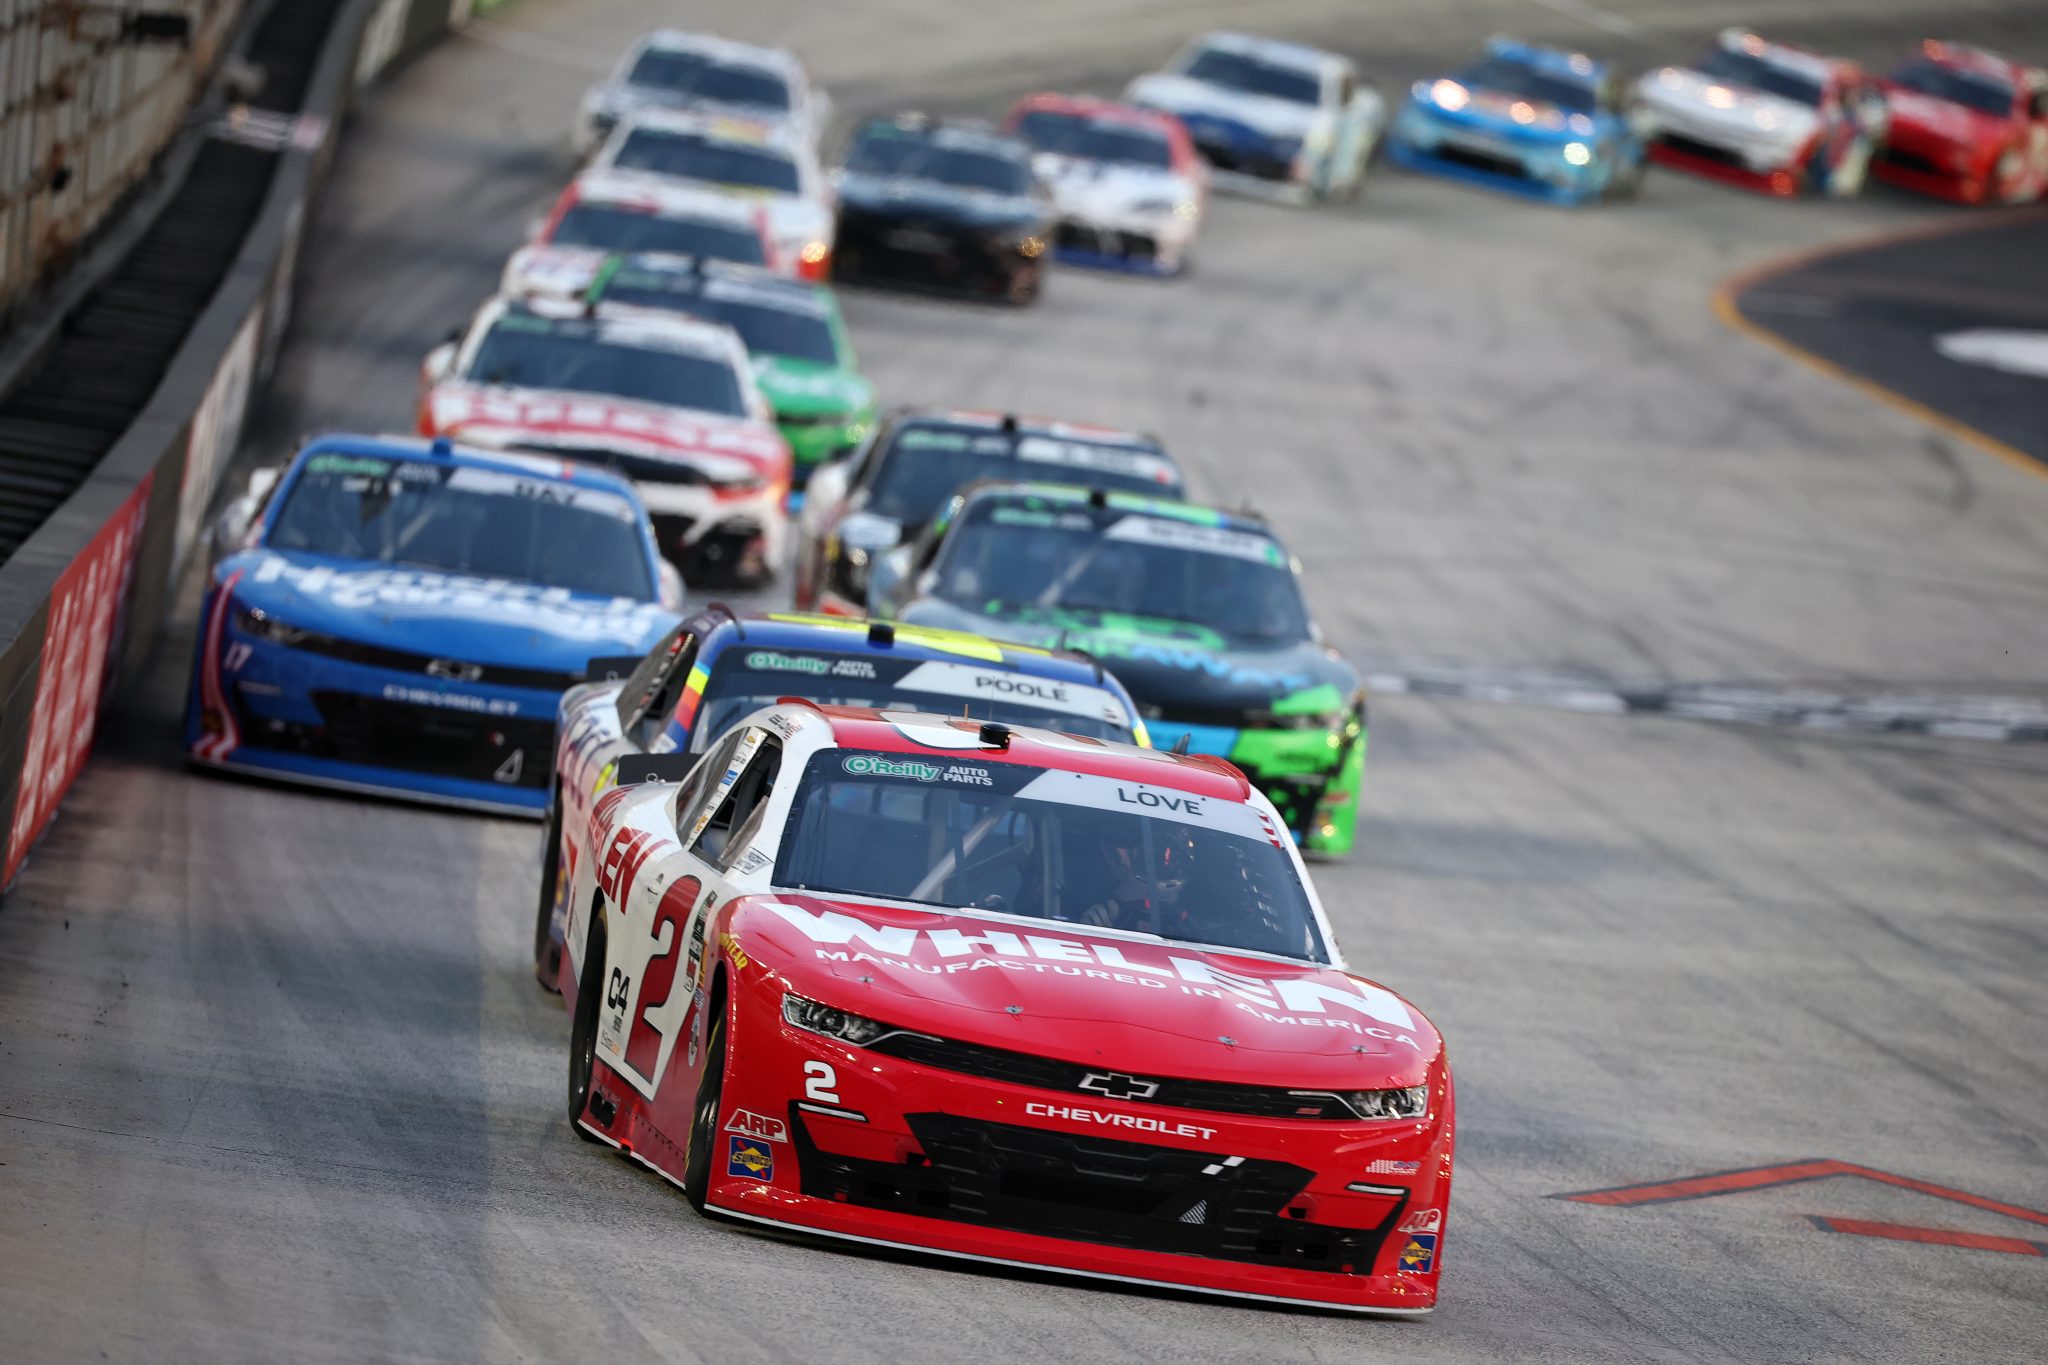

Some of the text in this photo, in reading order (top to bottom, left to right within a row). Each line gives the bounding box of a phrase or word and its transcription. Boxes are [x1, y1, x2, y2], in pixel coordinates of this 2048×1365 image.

[832, 667, 876, 679] PARTS
[838, 660, 873, 670] AUTO
[975, 676, 1069, 701] POOLE
[845, 755, 941, 781] O'Reilly
[943, 772, 993, 786] PARTS
[948, 765, 989, 777] AUTO
[1117, 787, 1203, 816] LOVE
[624, 874, 702, 1086] 2
[758, 903, 1417, 1033] WHELEN
[815, 949, 1422, 1051] MANUFACTURED IN AMERICA
[803, 1060, 840, 1104] 2
[728, 1111, 783, 1137] ARP
[1025, 1102, 1218, 1140] CHEVROLET
[732, 1152, 772, 1168] SUNOCO
